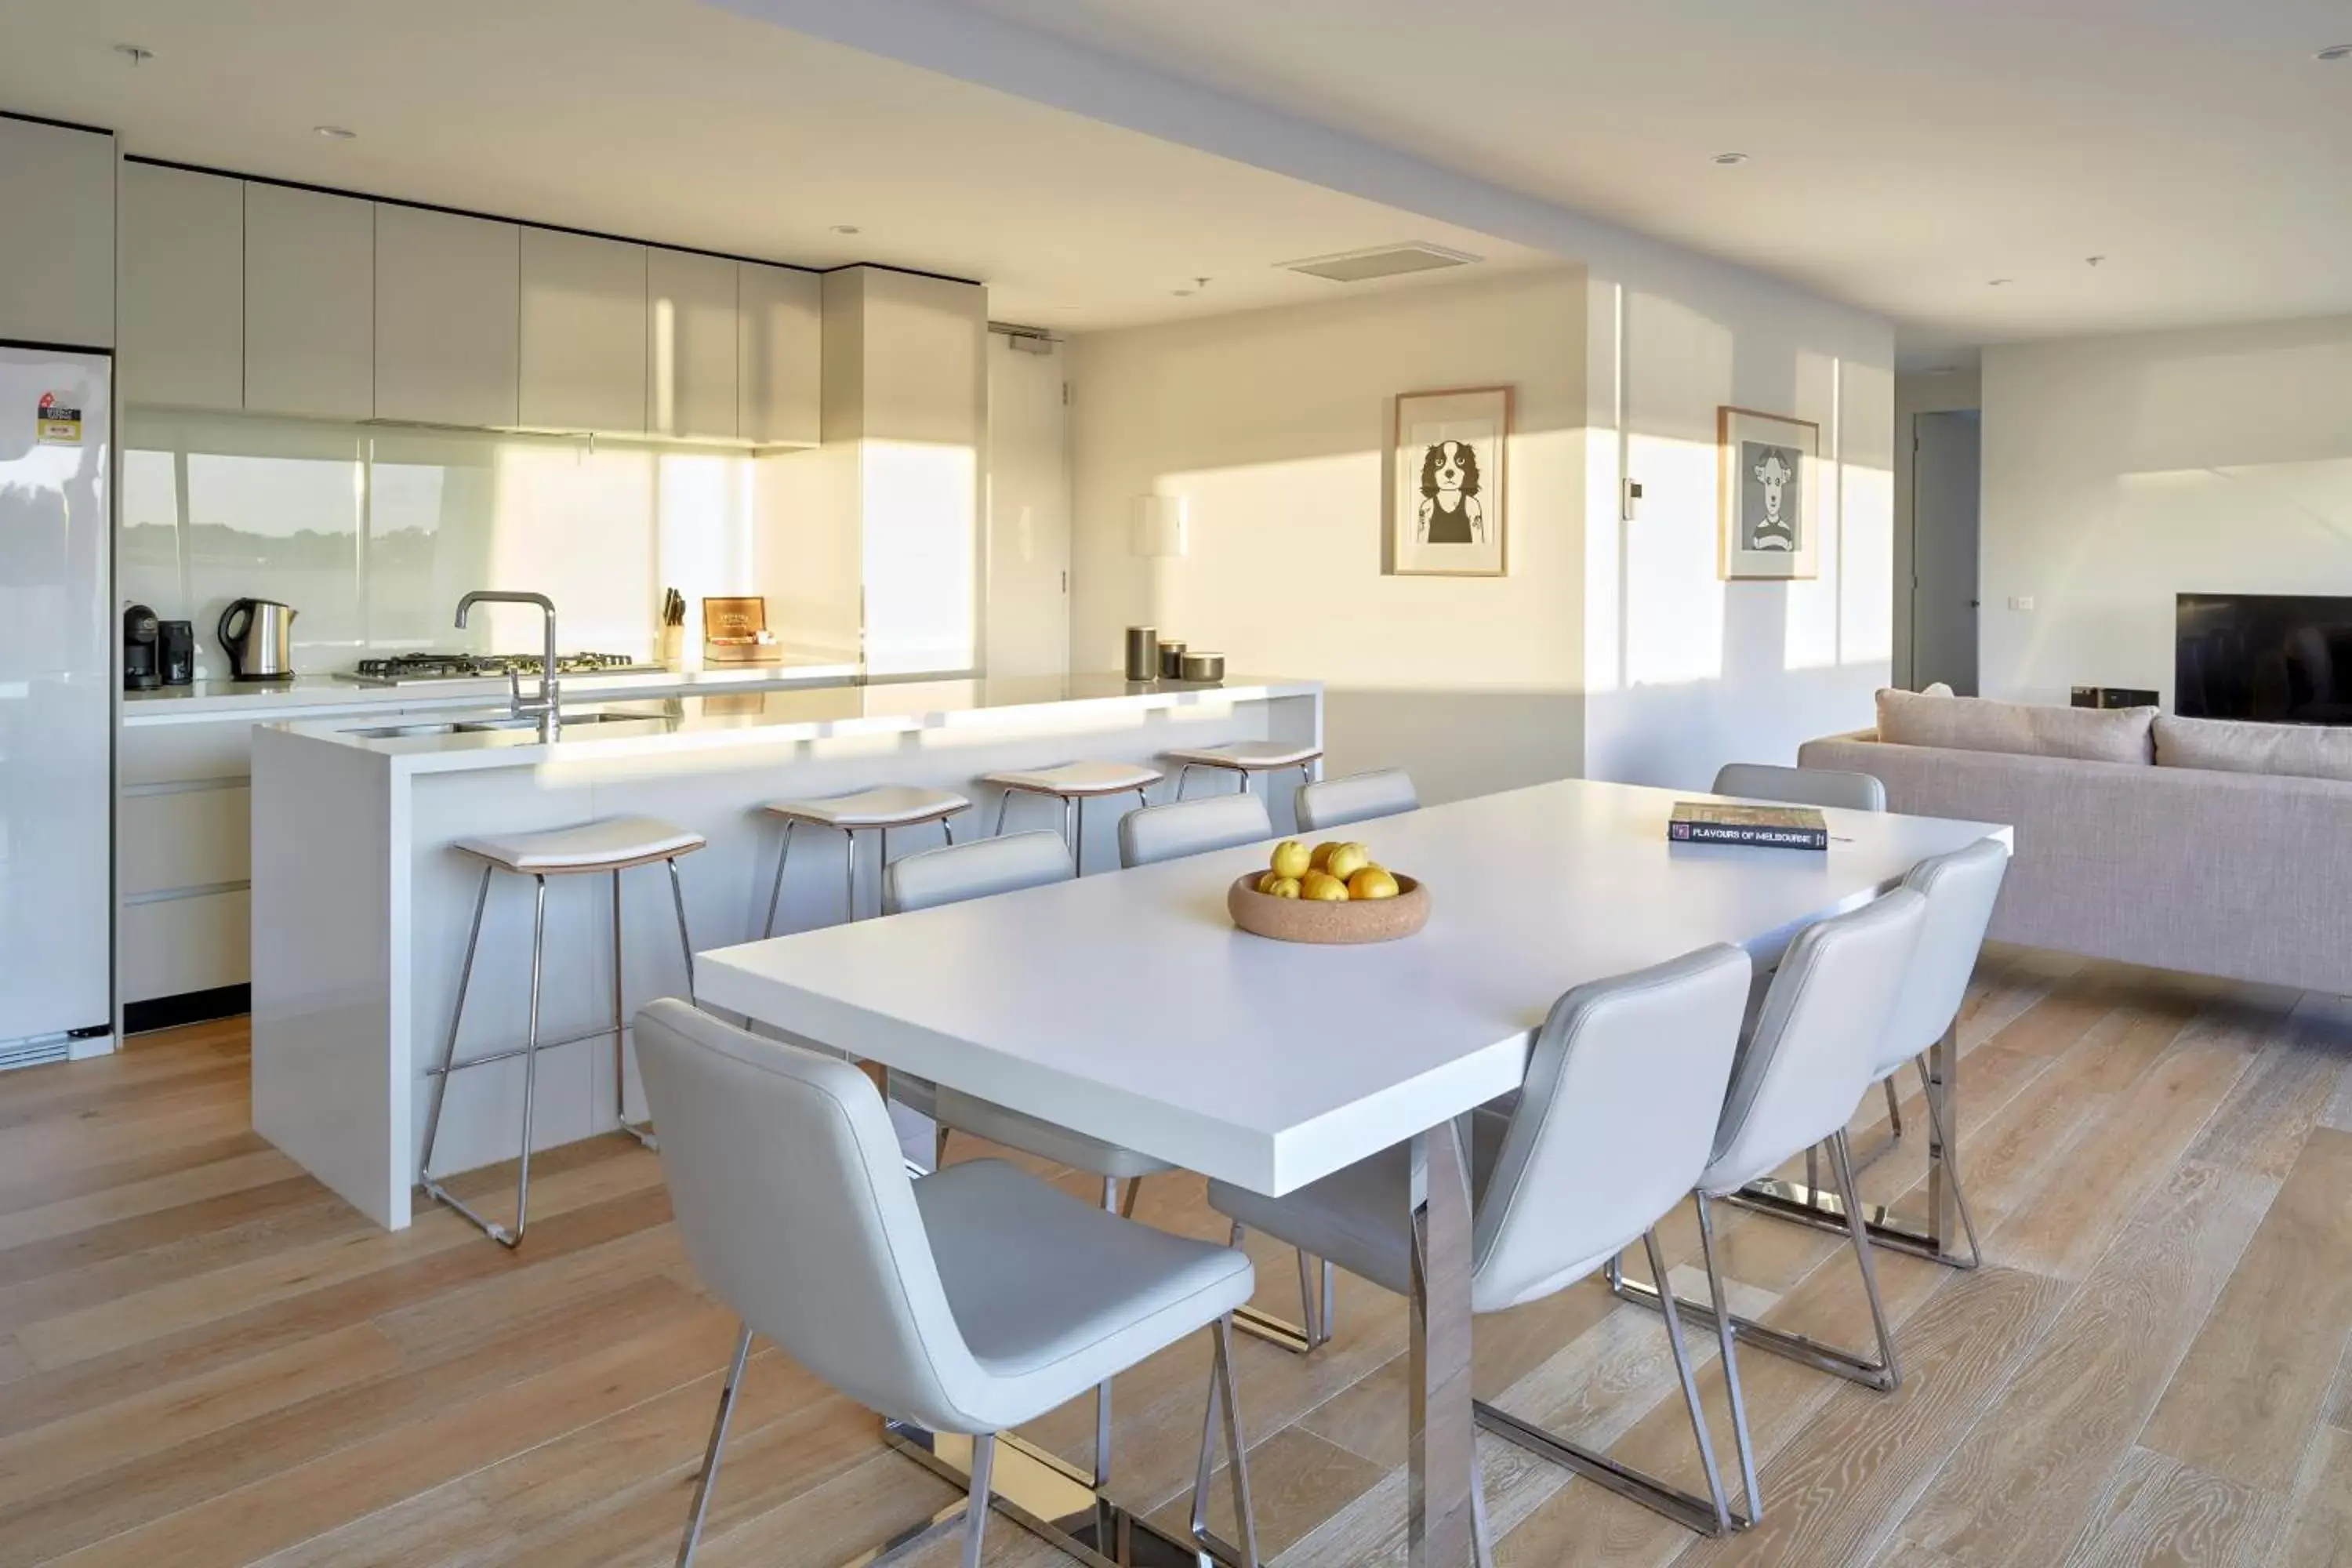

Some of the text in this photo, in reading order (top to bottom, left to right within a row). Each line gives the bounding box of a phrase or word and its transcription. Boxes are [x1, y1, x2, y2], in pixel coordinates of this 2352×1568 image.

[1693, 828, 1740, 839] FLAVOURS
[1741, 831, 1752, 840] OF
[1756, 832, 1811, 844] MELBOURNE
